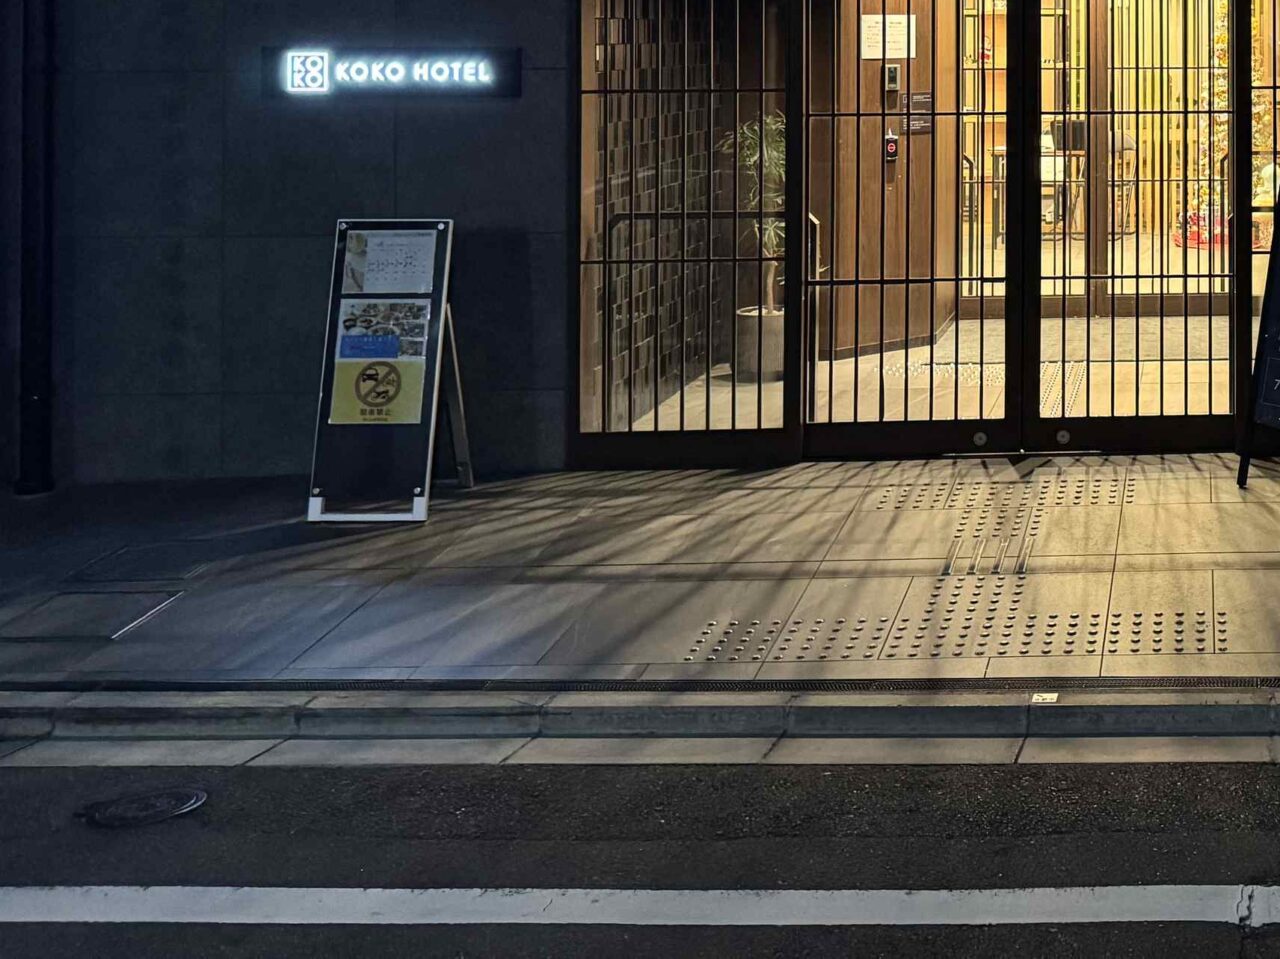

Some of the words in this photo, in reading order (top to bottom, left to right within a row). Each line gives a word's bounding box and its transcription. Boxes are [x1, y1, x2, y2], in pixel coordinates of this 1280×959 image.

[292, 56, 323, 72] KO
[335, 61, 406, 82] KOKO
[413, 61, 491, 82] HOTEL
[292, 71, 323, 87] KO
